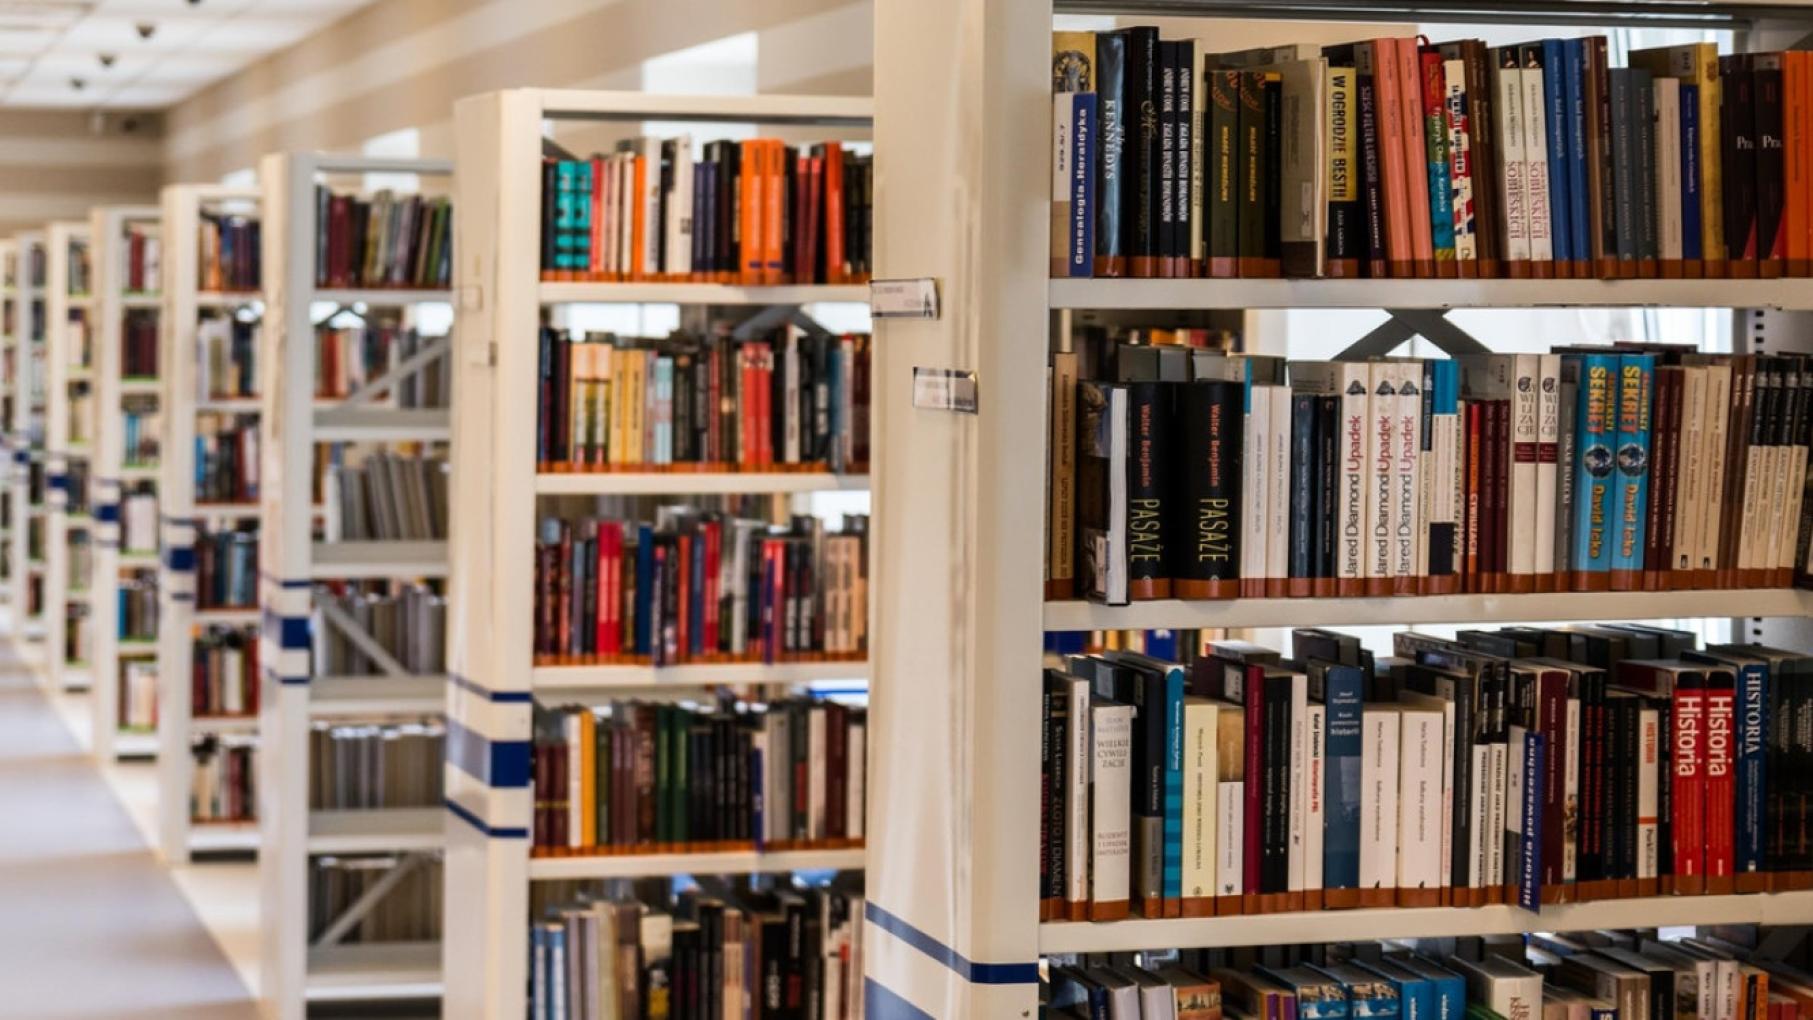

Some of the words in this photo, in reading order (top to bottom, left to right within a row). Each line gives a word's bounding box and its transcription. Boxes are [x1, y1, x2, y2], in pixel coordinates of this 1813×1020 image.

[1332, 75, 1346, 88] W
[1104, 99, 1116, 180] KENNEDYS
[1332, 91, 1346, 153] OGRODZIE
[1074, 108, 1087, 265] Genealogia.Heraldyka
[1332, 159, 1346, 198] BESTII
[1506, 161, 1520, 239] SOBIESKICH
[1529, 161, 1544, 239] SOBIESKICH
[1141, 404, 1152, 437] Walter
[1210, 404, 1221, 437] Walter
[1588, 366, 1606, 434] SEKRET
[1621, 366, 1640, 434] SEKRET
[1139, 440, 1152, 487] Benjamin
[1208, 440, 1221, 487] Benjamin
[1346, 416, 1364, 472] Upadek
[1376, 416, 1393, 472] Upadek
[1399, 416, 1416, 472] Upadek
[1130, 498, 1164, 562] PASAŻE
[1198, 498, 1232, 562] PASAŻE
[1345, 473, 1360, 537] Diamond
[1374, 472, 1390, 537] Diamond
[1397, 473, 1412, 537] Diamond
[1591, 484, 1604, 523] David
[1623, 483, 1638, 522] David
[1345, 539, 1359, 577] Jared
[1374, 539, 1388, 577] Jared
[1397, 539, 1411, 577] Jared
[1590, 527, 1603, 558] Icke
[1622, 527, 1637, 557] Icke
[1677, 696, 1702, 777] Historia
[1707, 696, 1733, 777] Historia
[1744, 672, 1761, 755] HISTORIA
[1524, 737, 1536, 838] powszechna
[1052, 846, 1064, 897] DIAMEN
[1523, 841, 1533, 906] Historia
